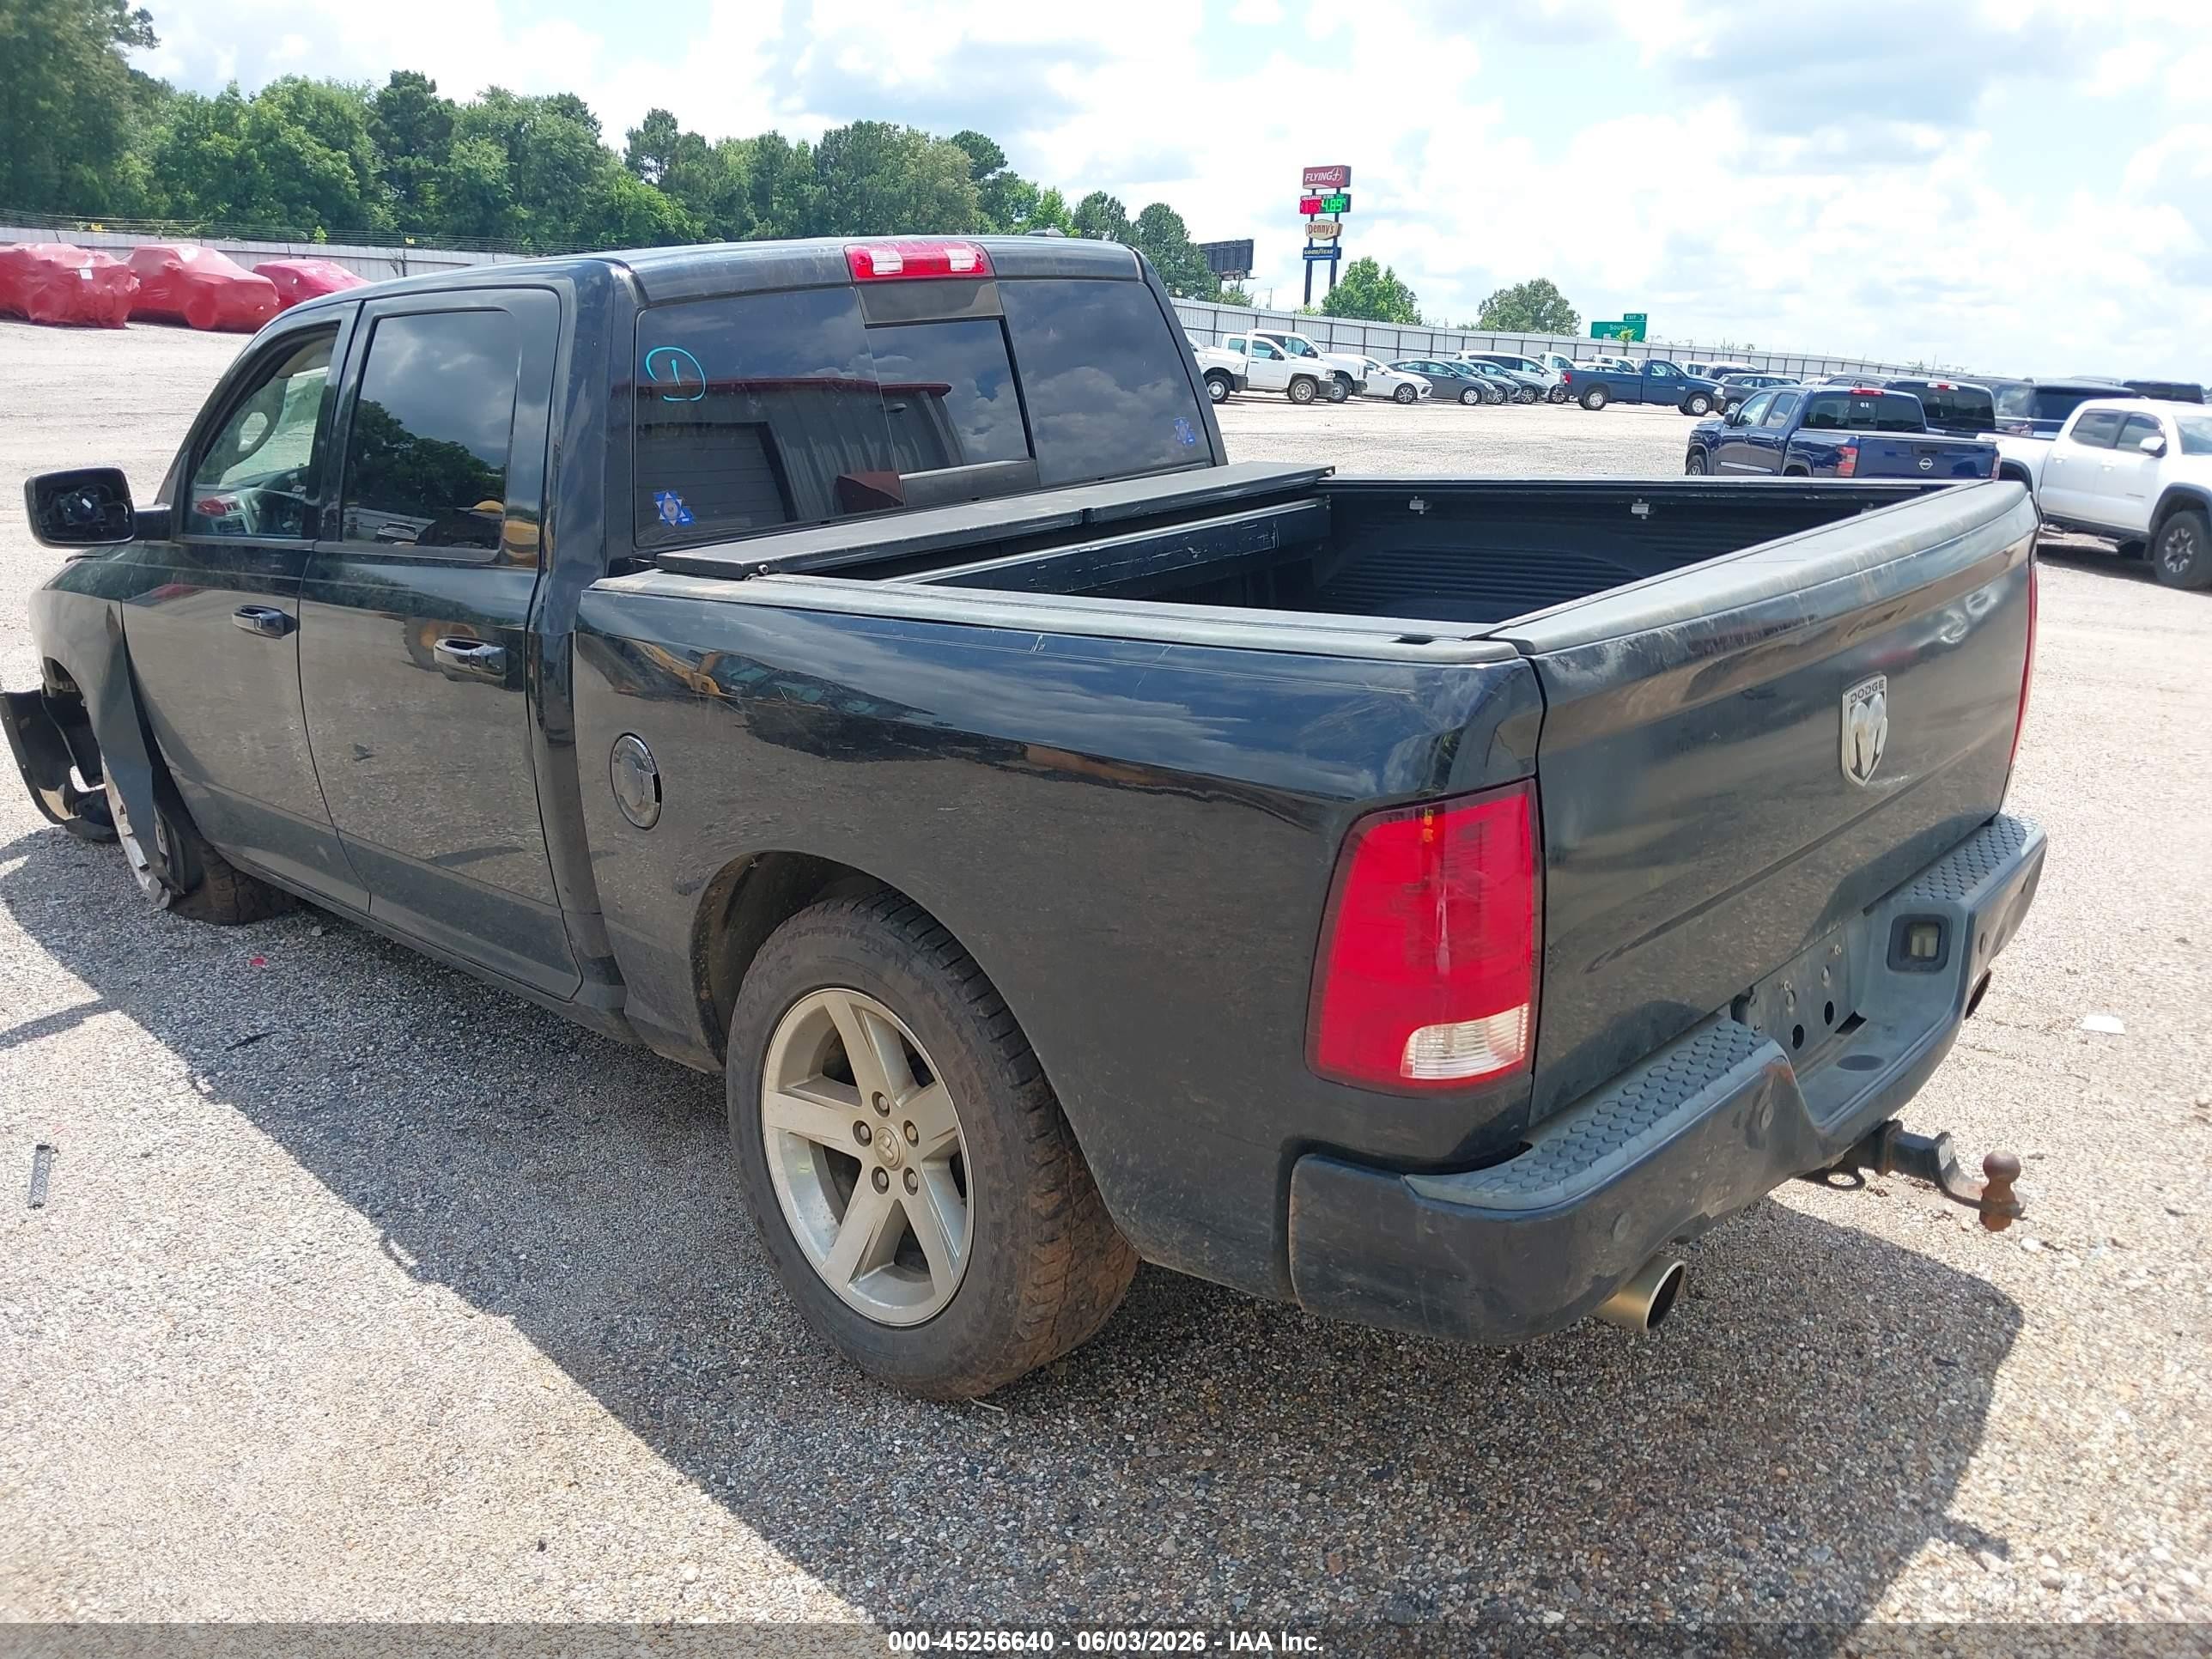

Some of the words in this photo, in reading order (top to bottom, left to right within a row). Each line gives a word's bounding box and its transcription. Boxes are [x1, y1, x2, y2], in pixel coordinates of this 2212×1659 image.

[1304, 172, 1333, 182] FLYING
[1308, 224, 1334, 234] Denny's
[1850, 679, 1885, 704] DODGE
